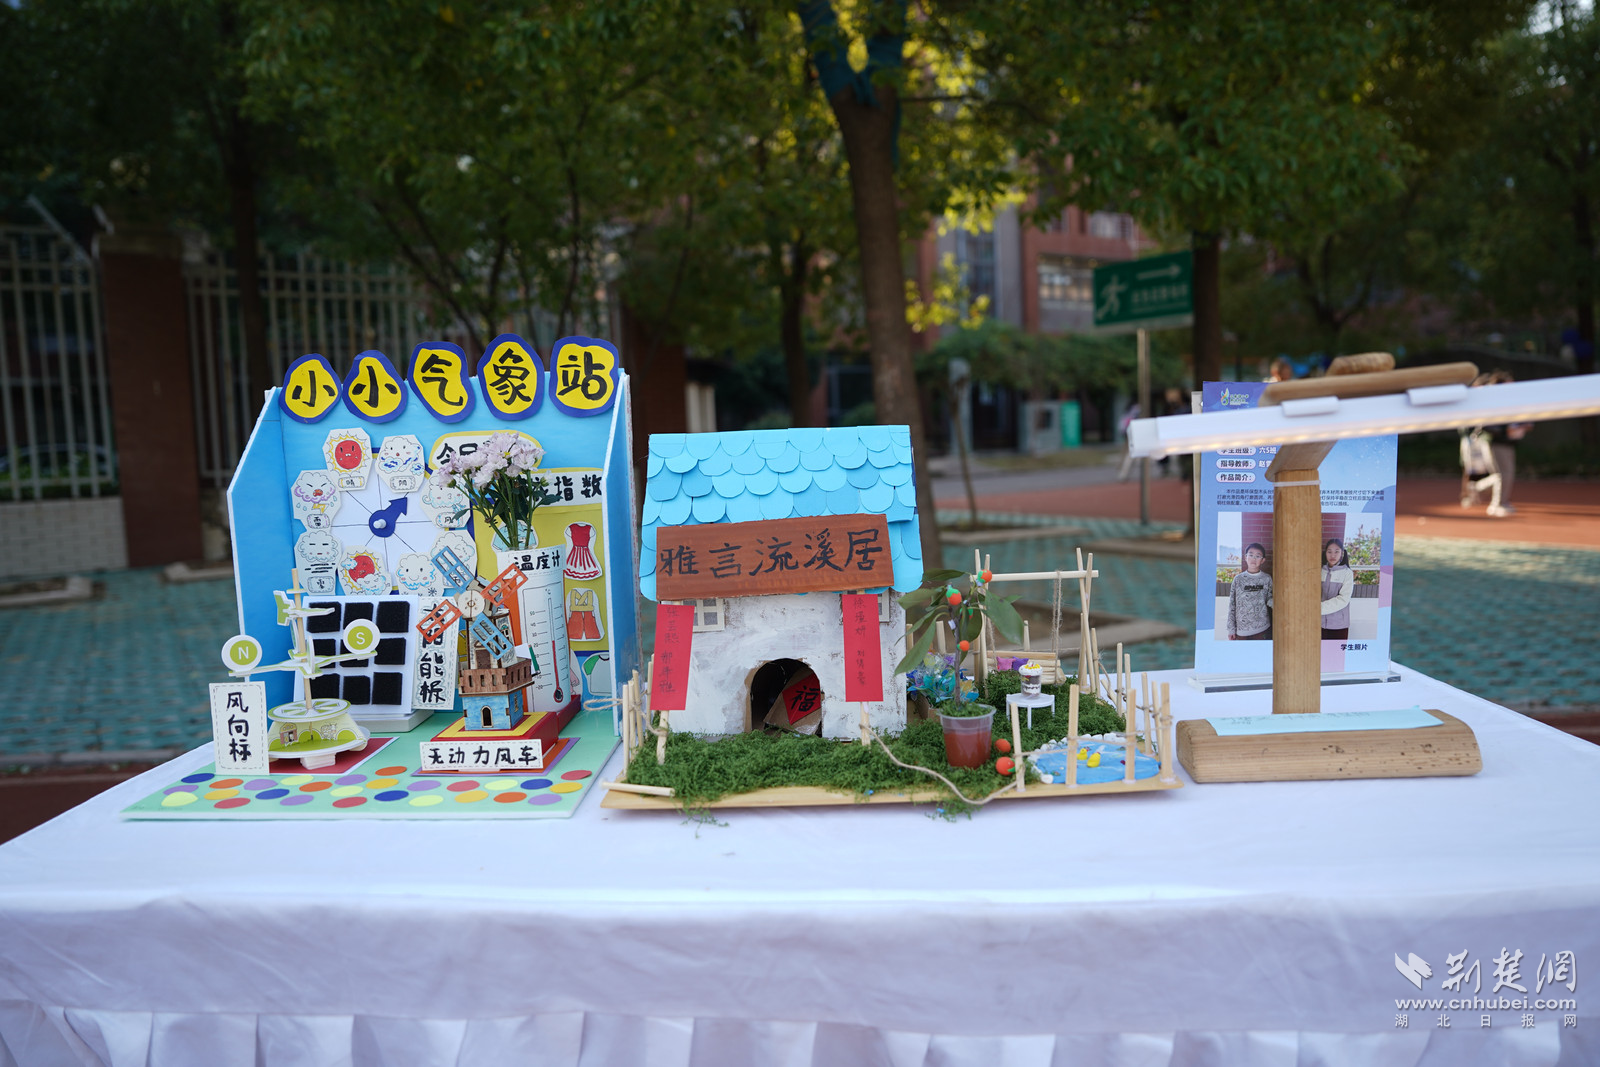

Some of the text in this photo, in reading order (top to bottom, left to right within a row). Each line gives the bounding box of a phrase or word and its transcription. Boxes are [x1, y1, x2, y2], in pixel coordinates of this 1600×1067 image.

[292, 348, 608, 407] 小小气象站
[513, 550, 561, 571] 温度计
[659, 527, 883, 580] 雅言流溪居
[355, 631, 367, 646] S
[1340, 643, 1368, 651] 学生照片
[237, 646, 250, 660] N
[791, 686, 822, 711] 福
[226, 691, 252, 764] 风向标
[427, 744, 539, 768] 无动力风车
